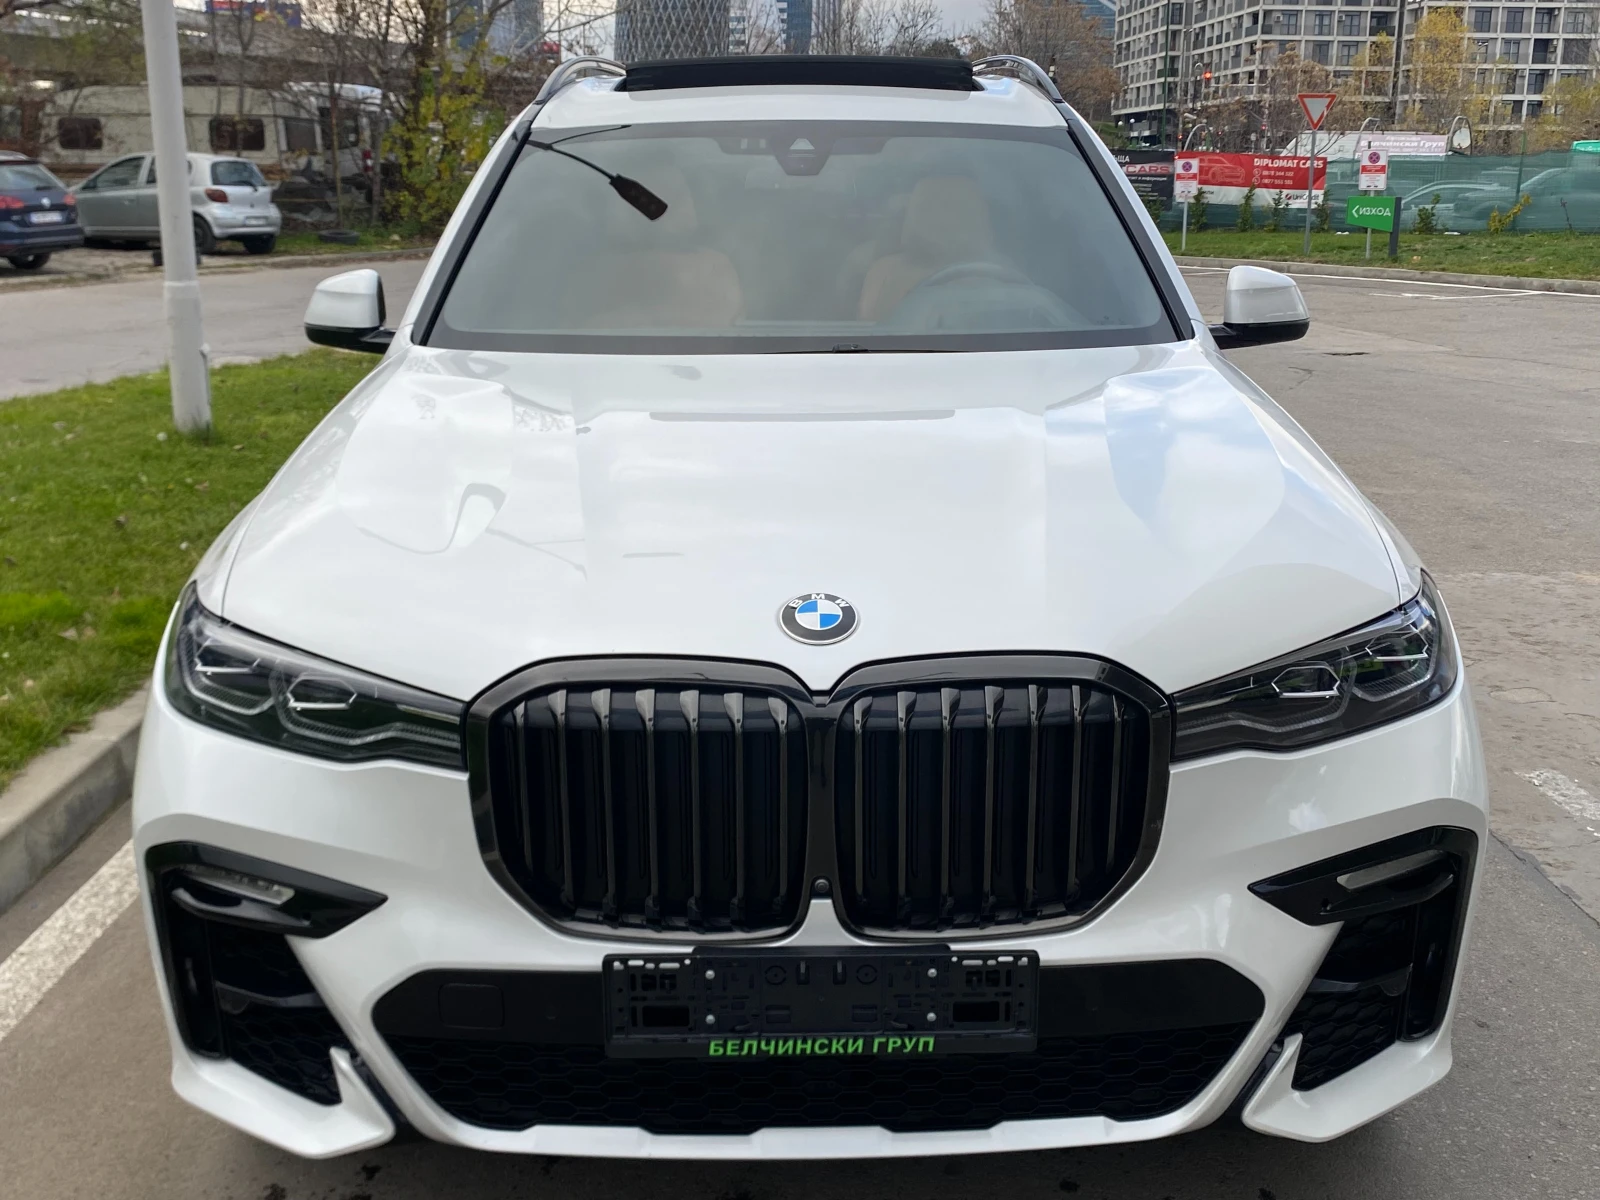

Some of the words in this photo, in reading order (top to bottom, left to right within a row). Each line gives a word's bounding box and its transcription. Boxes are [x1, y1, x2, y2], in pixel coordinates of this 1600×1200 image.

[1419, 140, 1445, 148] Груп
[1253, 158, 1298, 168] DIPLOMAT
[1126, 164, 1171, 174] CARS
[1359, 207, 1391, 216] ИЗХОД
[788, 593, 850, 608] BMW
[708, 1037, 864, 1056] БЕЛЧИНСКИ
[872, 1036, 936, 1054] ГРУП
